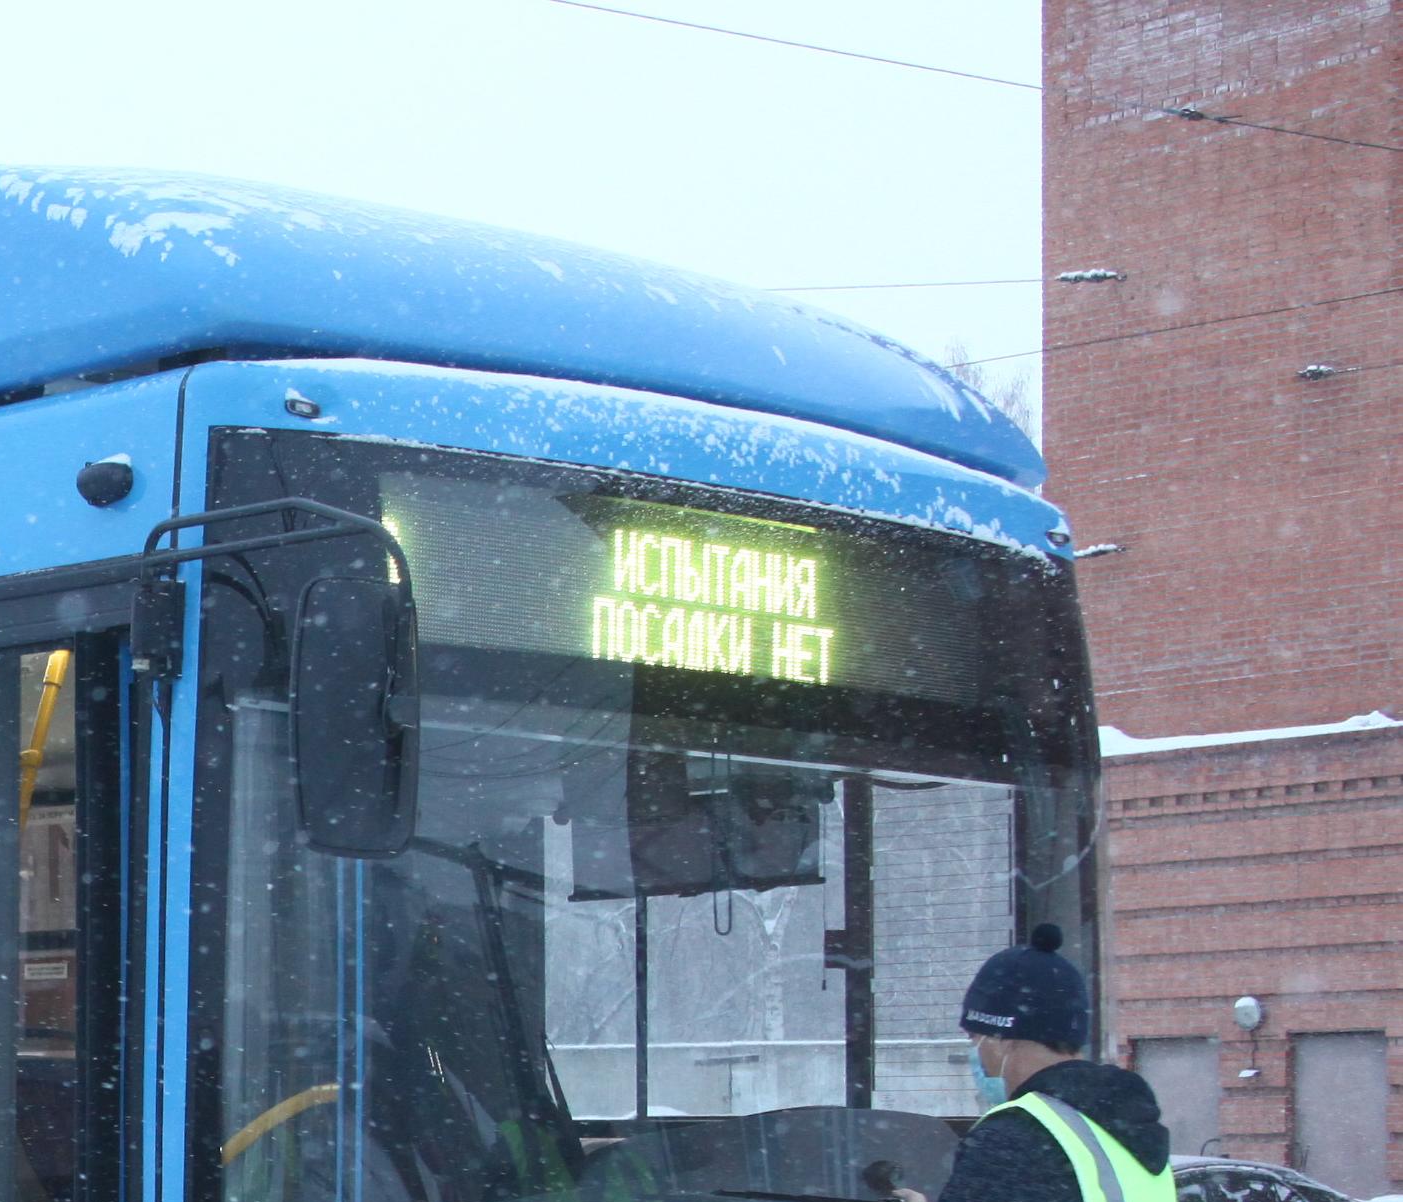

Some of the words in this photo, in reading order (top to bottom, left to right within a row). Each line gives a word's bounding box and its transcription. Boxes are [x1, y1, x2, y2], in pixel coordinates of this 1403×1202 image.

[613, 529, 817, 620] ИСПЫТАНИЯ
[592, 595, 753, 677] ПОСАДКИ
[771, 620, 835, 686] НЕТ
